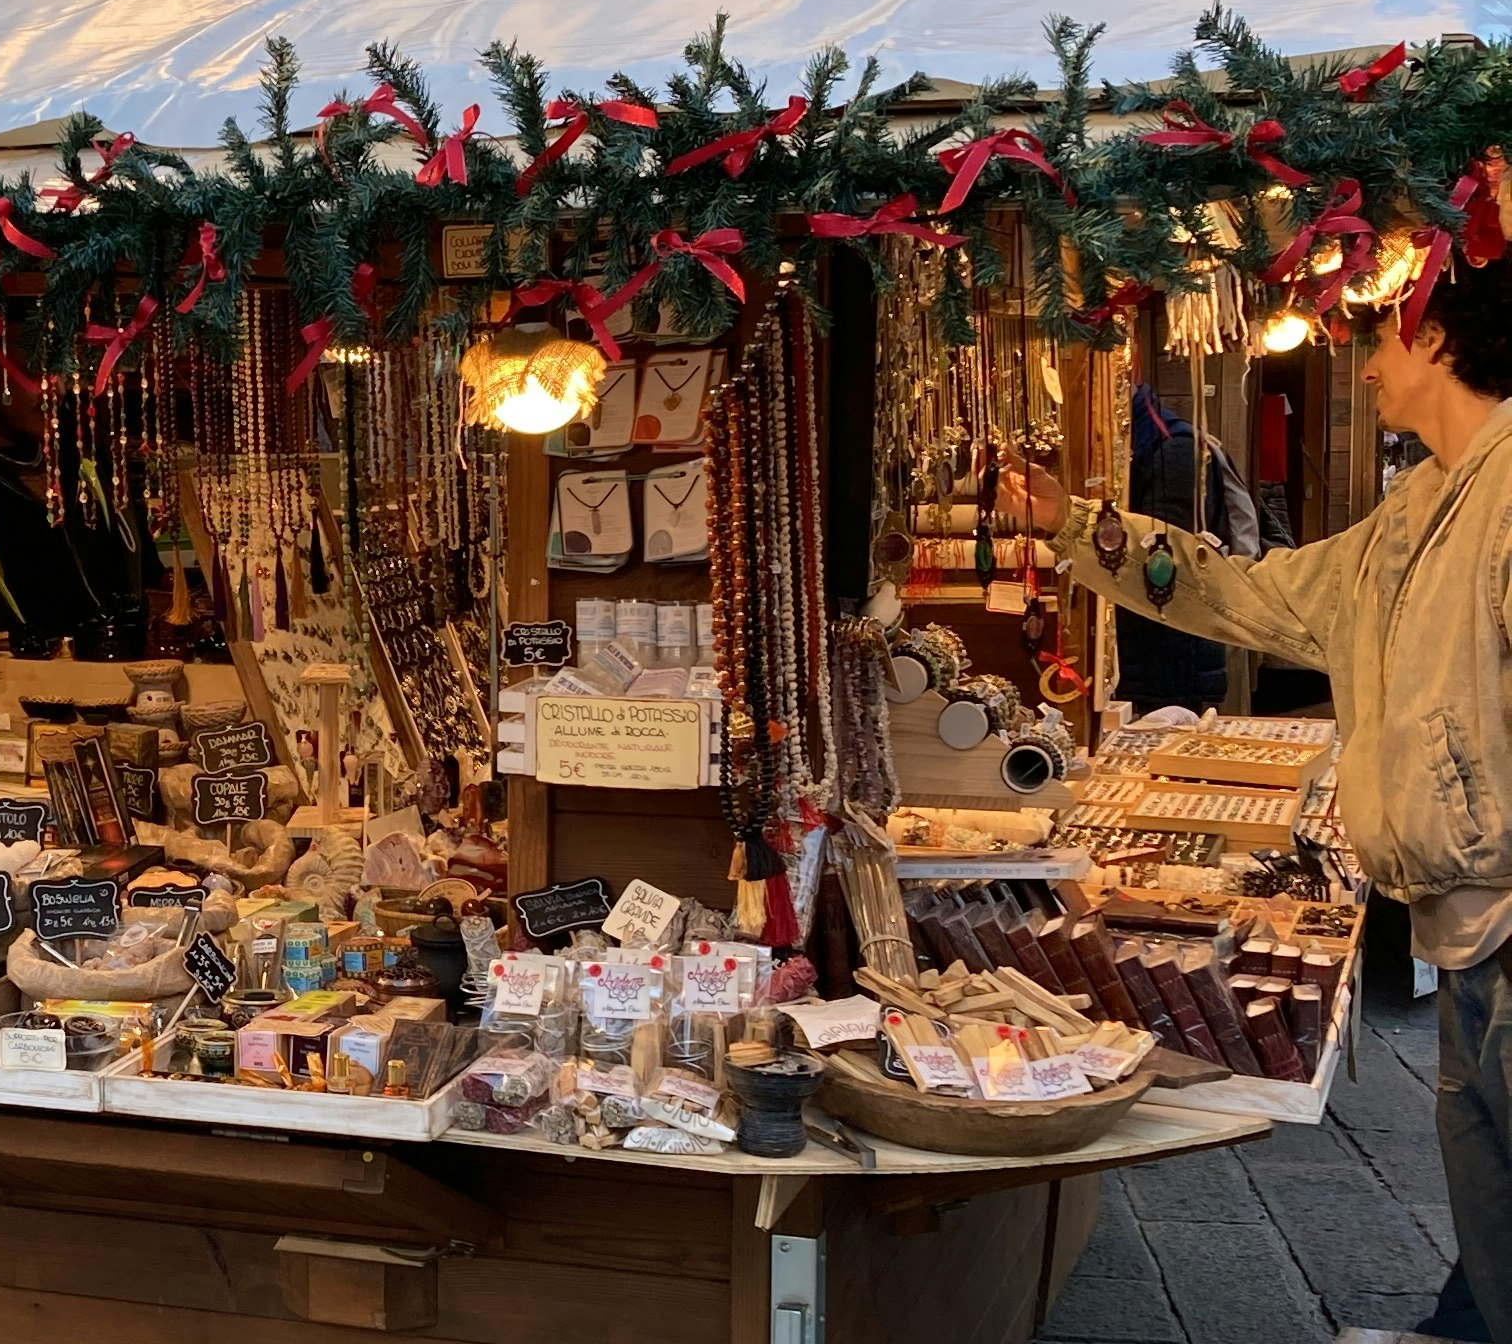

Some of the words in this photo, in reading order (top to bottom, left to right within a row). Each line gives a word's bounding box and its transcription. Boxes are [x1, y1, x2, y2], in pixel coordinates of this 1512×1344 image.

[522, 647, 546, 662] 5€
[541, 702, 614, 723] CRISTALLO
[628, 706, 698, 723] POTASSIO
[554, 725, 606, 736] ALLUME
[624, 726, 667, 738] ROCCA
[548, 739, 610, 751] DEODORANTE
[617, 743, 674, 752] NATURALE
[558, 760, 586, 779] 5€
[209, 782, 249, 796] COPALE
[233, 796, 246, 806] 5€
[149, 898, 183, 907] MIRRA
[631, 885, 664, 910] SALVIA
[620, 900, 661, 929] GRANDE
[19, 1052, 43, 1064] 5€
